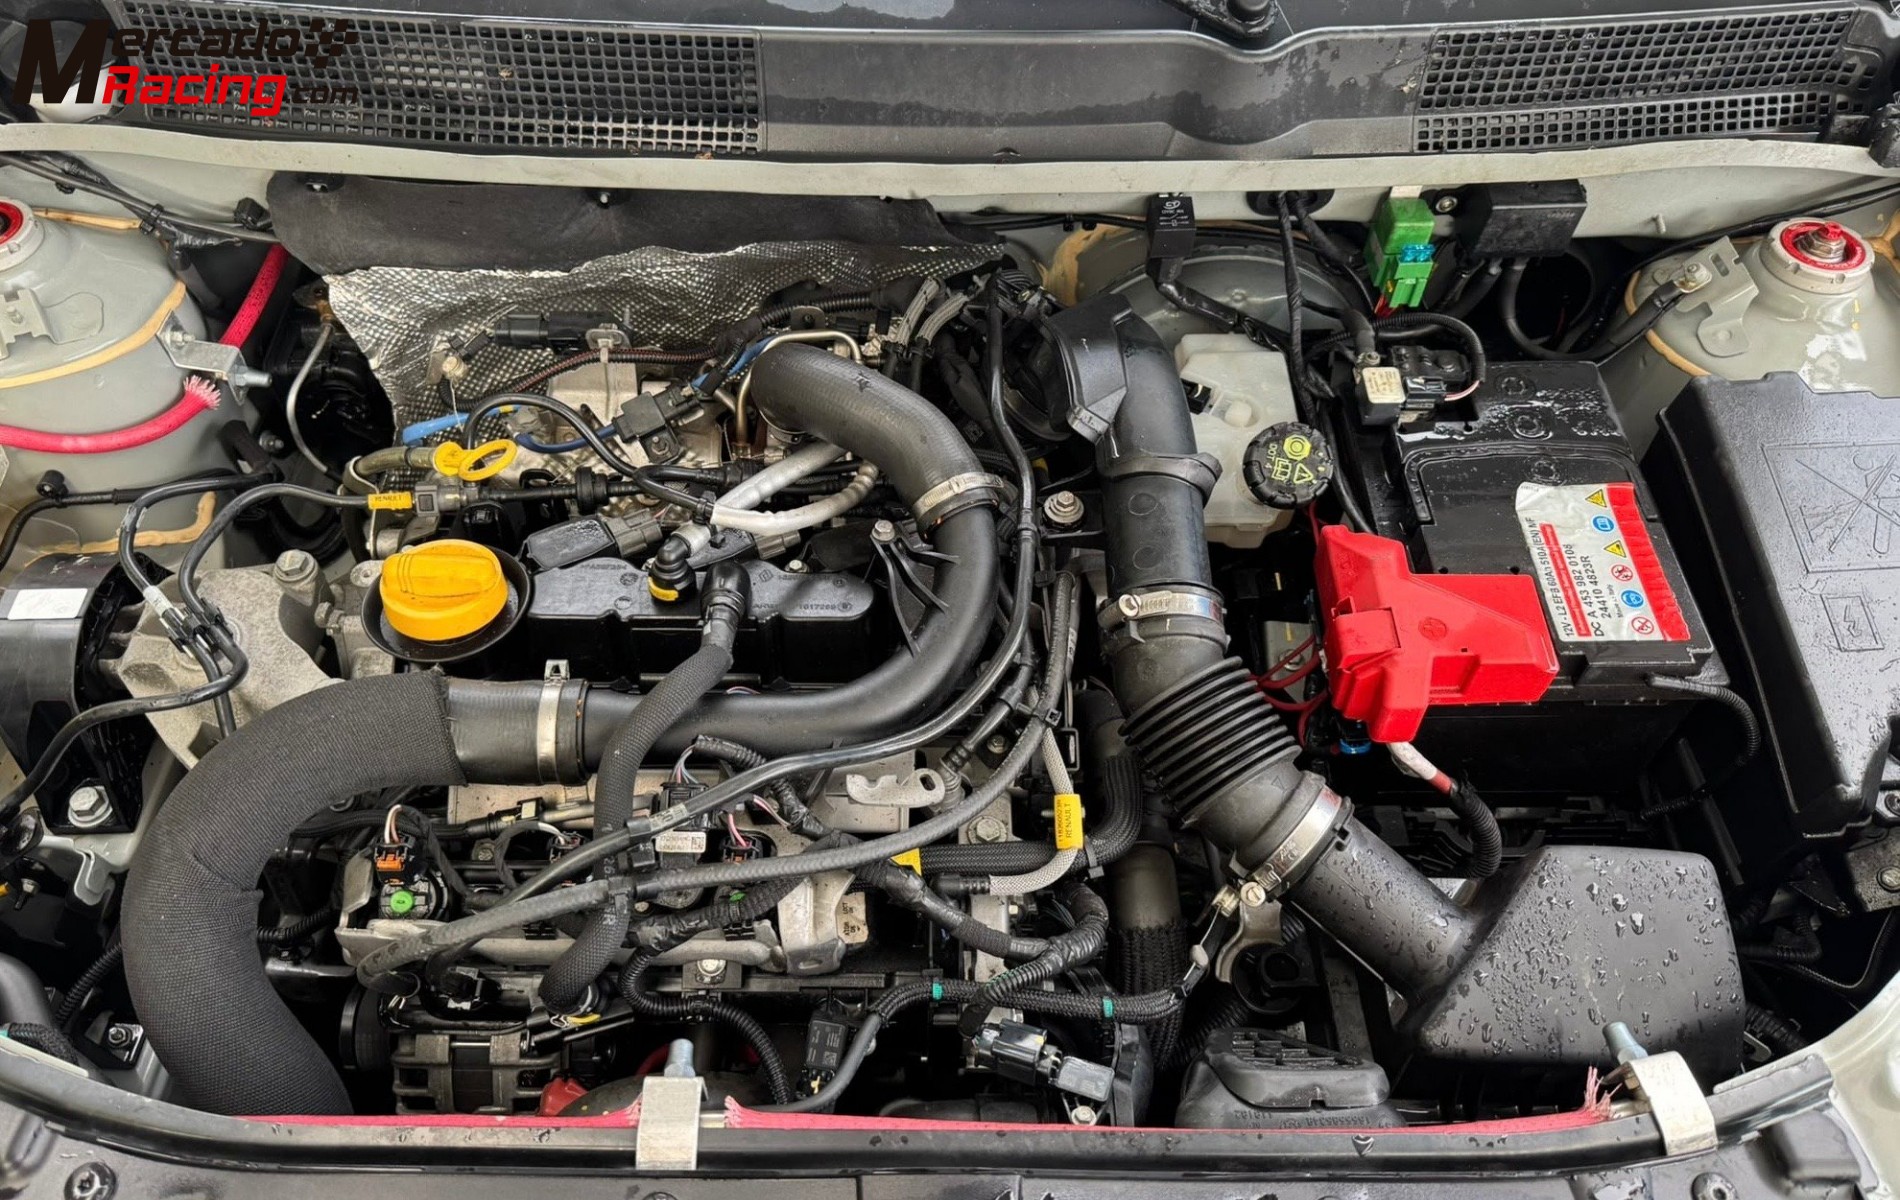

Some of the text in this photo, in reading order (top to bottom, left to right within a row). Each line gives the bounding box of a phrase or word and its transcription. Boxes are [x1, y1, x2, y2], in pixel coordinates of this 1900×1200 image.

[1267, 443, 1278, 461] DOT
[1572, 569, 1586, 587] 982
[1580, 555, 1612, 619] 24410 4823R
[1579, 589, 1593, 607] 453
[1556, 606, 1567, 616] L2
[1587, 611, 1598, 619] A
[1561, 622, 1574, 637] 12V
[1591, 622, 1604, 637] DC
[1064, 803, 1072, 838] RENAULT
